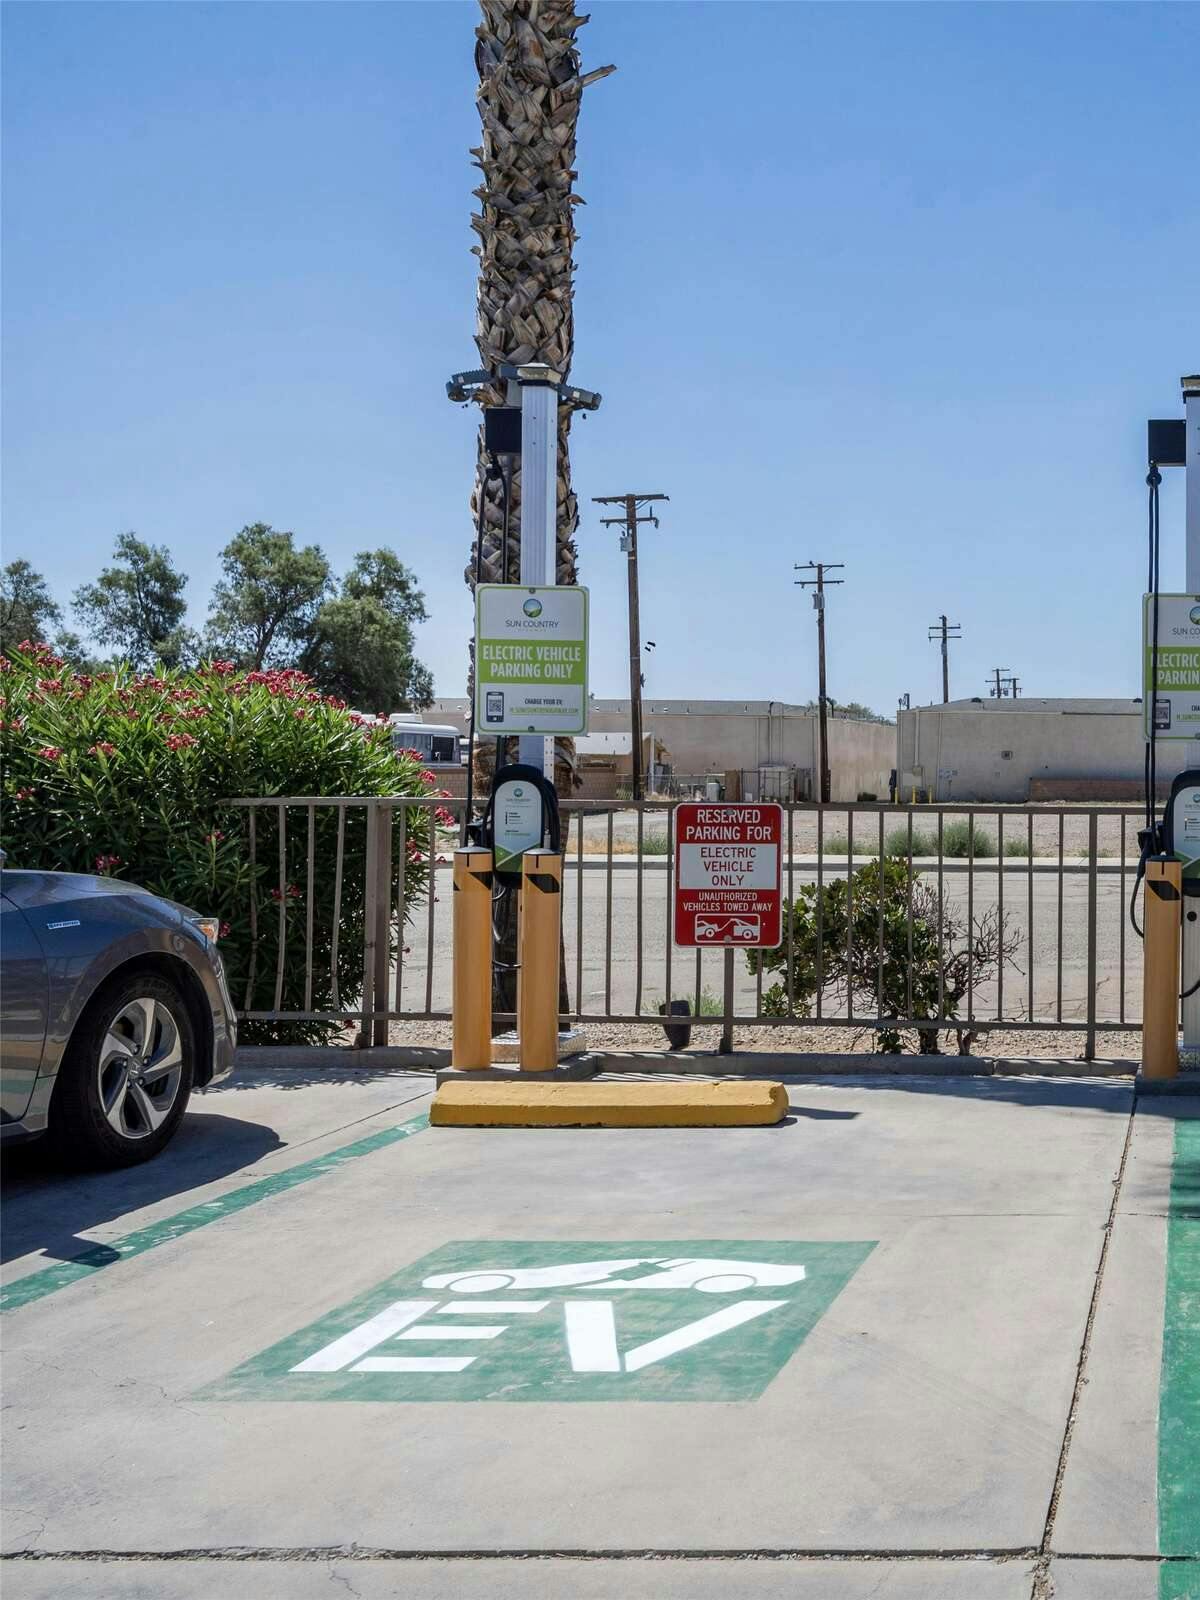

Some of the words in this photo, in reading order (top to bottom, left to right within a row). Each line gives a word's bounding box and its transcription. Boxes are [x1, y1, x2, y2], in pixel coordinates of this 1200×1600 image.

[505, 620, 521, 628] SUN
[522, 620, 559, 628] COUNTRY
[1172, 627, 1188, 635] SUN
[482, 645, 533, 660] ELECTRIC
[536, 646, 581, 661] VEHICLE
[1151, 653, 1199, 668] LECTRIC
[490, 663, 541, 678] PARKING
[544, 663, 573, 678] ONLY
[697, 809, 761, 823] RESERVED
[686, 826, 741, 841] PARKING
[747, 826, 772, 841] FOR
[701, 847, 757, 858] ELECTRIC
[704, 861, 754, 872] VEHICLE
[711, 875, 745, 886] ONLY
[698, 892, 758, 901] UNAUTHORIZED
[683, 902, 720, 911] VEHICLES
[723, 902, 749, 911] TOWED
[752, 902, 773, 911] AWAY
[288, 1300, 791, 1372] EV
